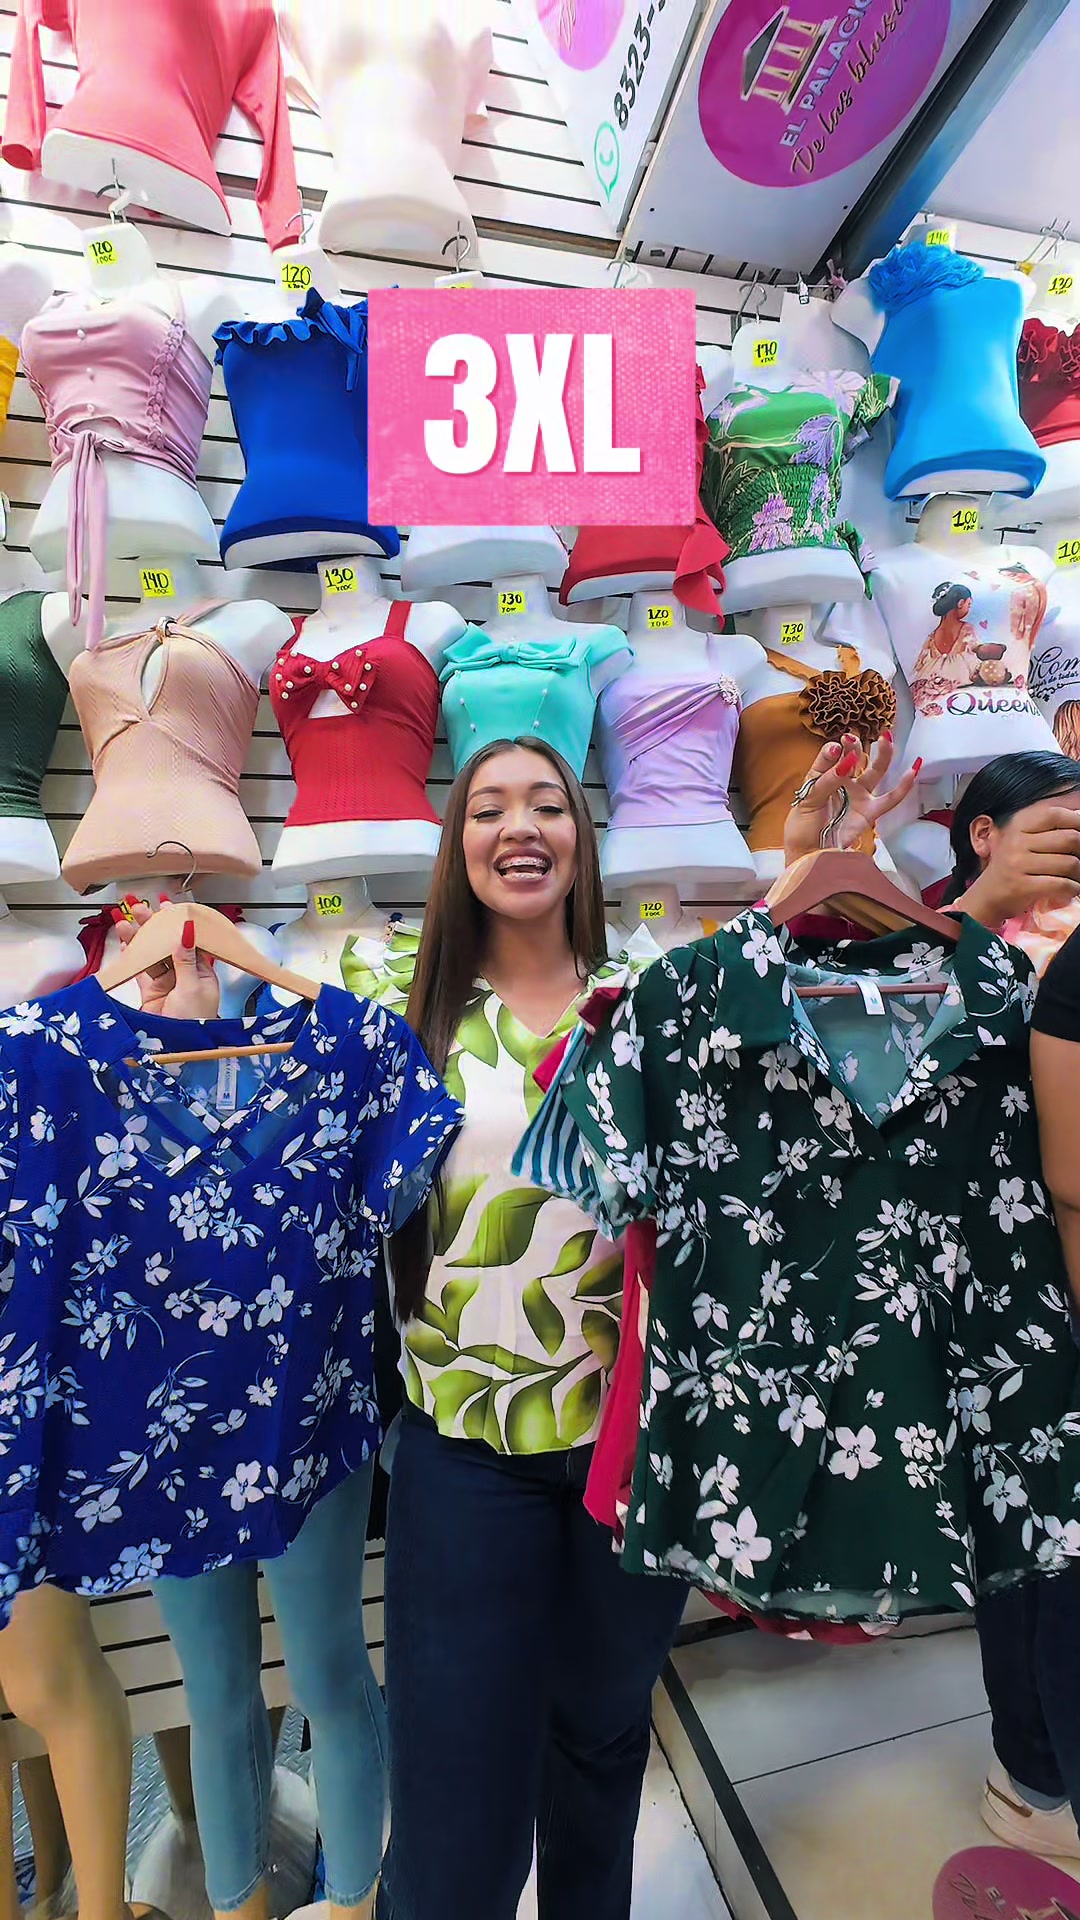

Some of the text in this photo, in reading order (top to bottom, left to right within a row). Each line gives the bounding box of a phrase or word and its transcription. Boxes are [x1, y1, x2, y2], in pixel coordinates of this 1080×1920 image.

[780, 118, 807, 147] EL
[790, 136, 825, 173] De
[818, 87, 853, 134] las
[90, 241, 113, 257] 120
[282, 264, 312, 285] 120
[953, 511, 977, 527] 100
[143, 571, 169, 590] 140
[325, 568, 353, 588] 130
[648, 608, 668, 619] 120
[946, 692, 1038, 716] Queen
[317, 895, 342, 909] 100
